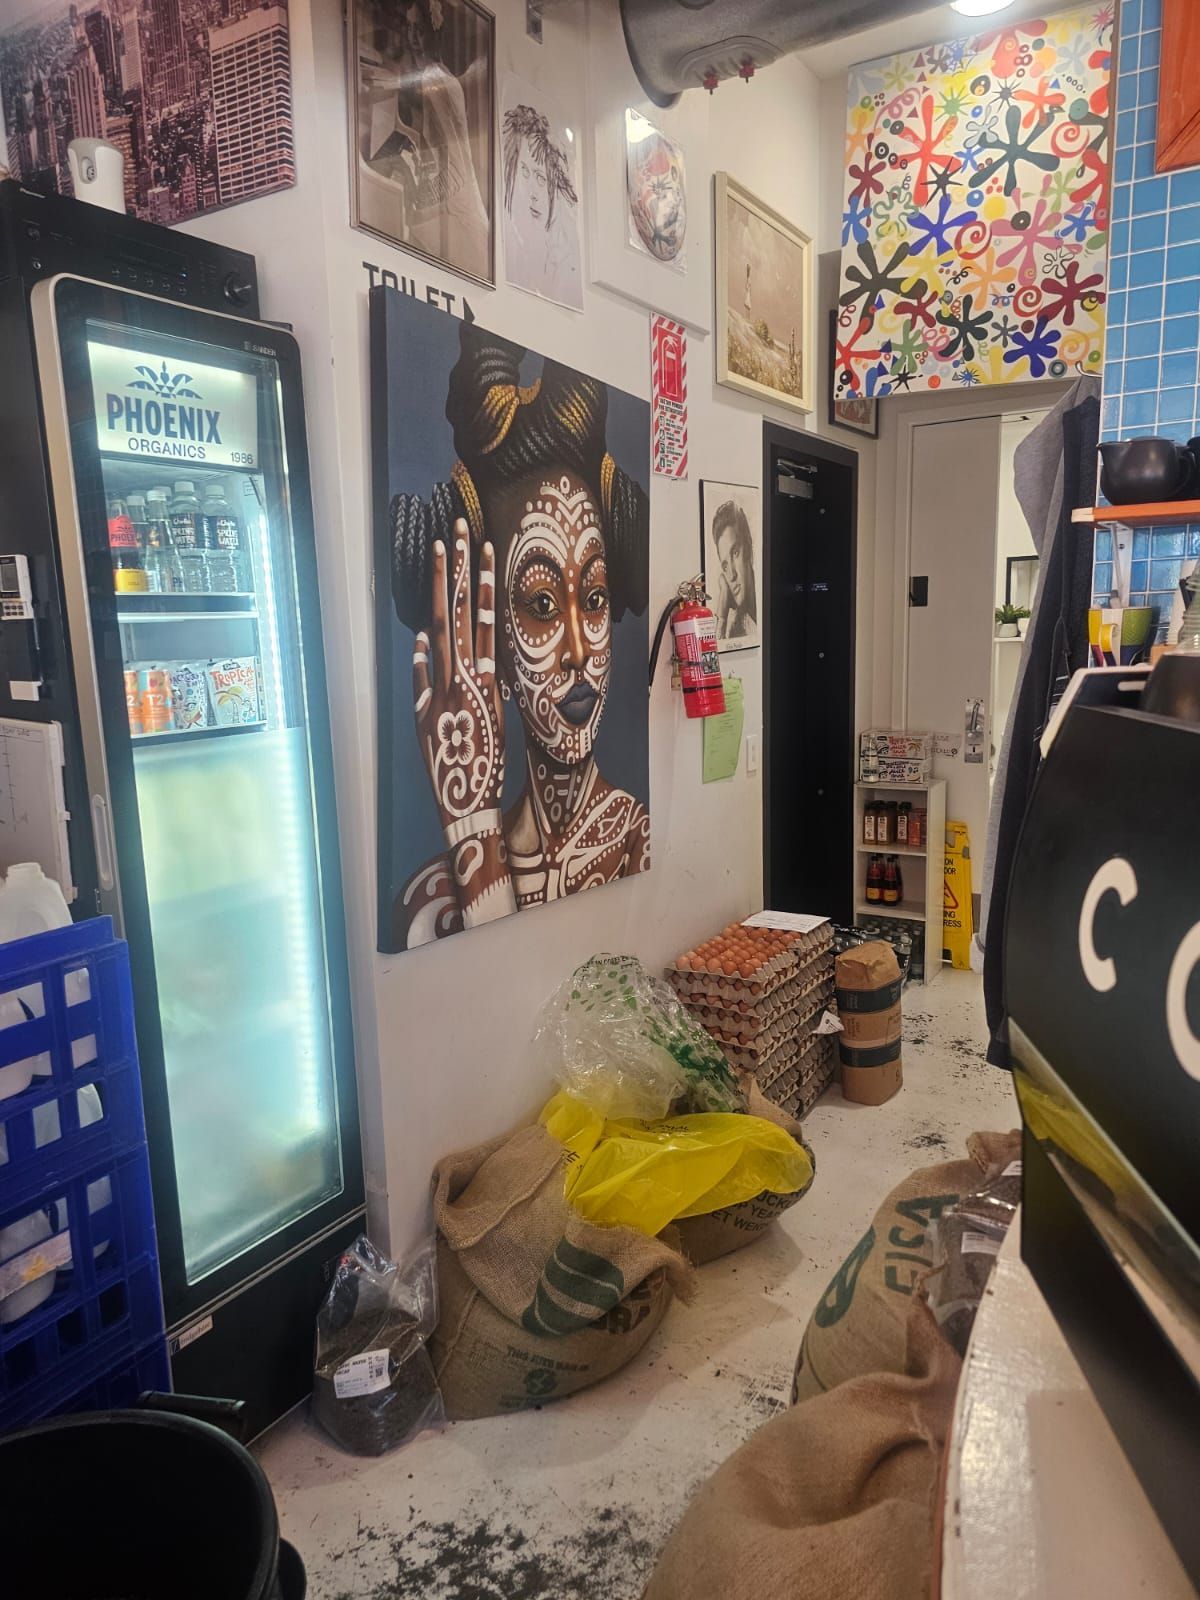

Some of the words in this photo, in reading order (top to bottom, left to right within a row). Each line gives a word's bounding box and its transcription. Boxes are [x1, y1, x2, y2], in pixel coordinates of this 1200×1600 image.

[106, 392, 222, 444] PHOENIX
[128, 437, 206, 459] ORGANICS
[230, 451, 254, 464] 1986
[146, 693, 164, 706] T2
[944, 911, 956, 919] ING
[944, 920, 962, 928] RESS
